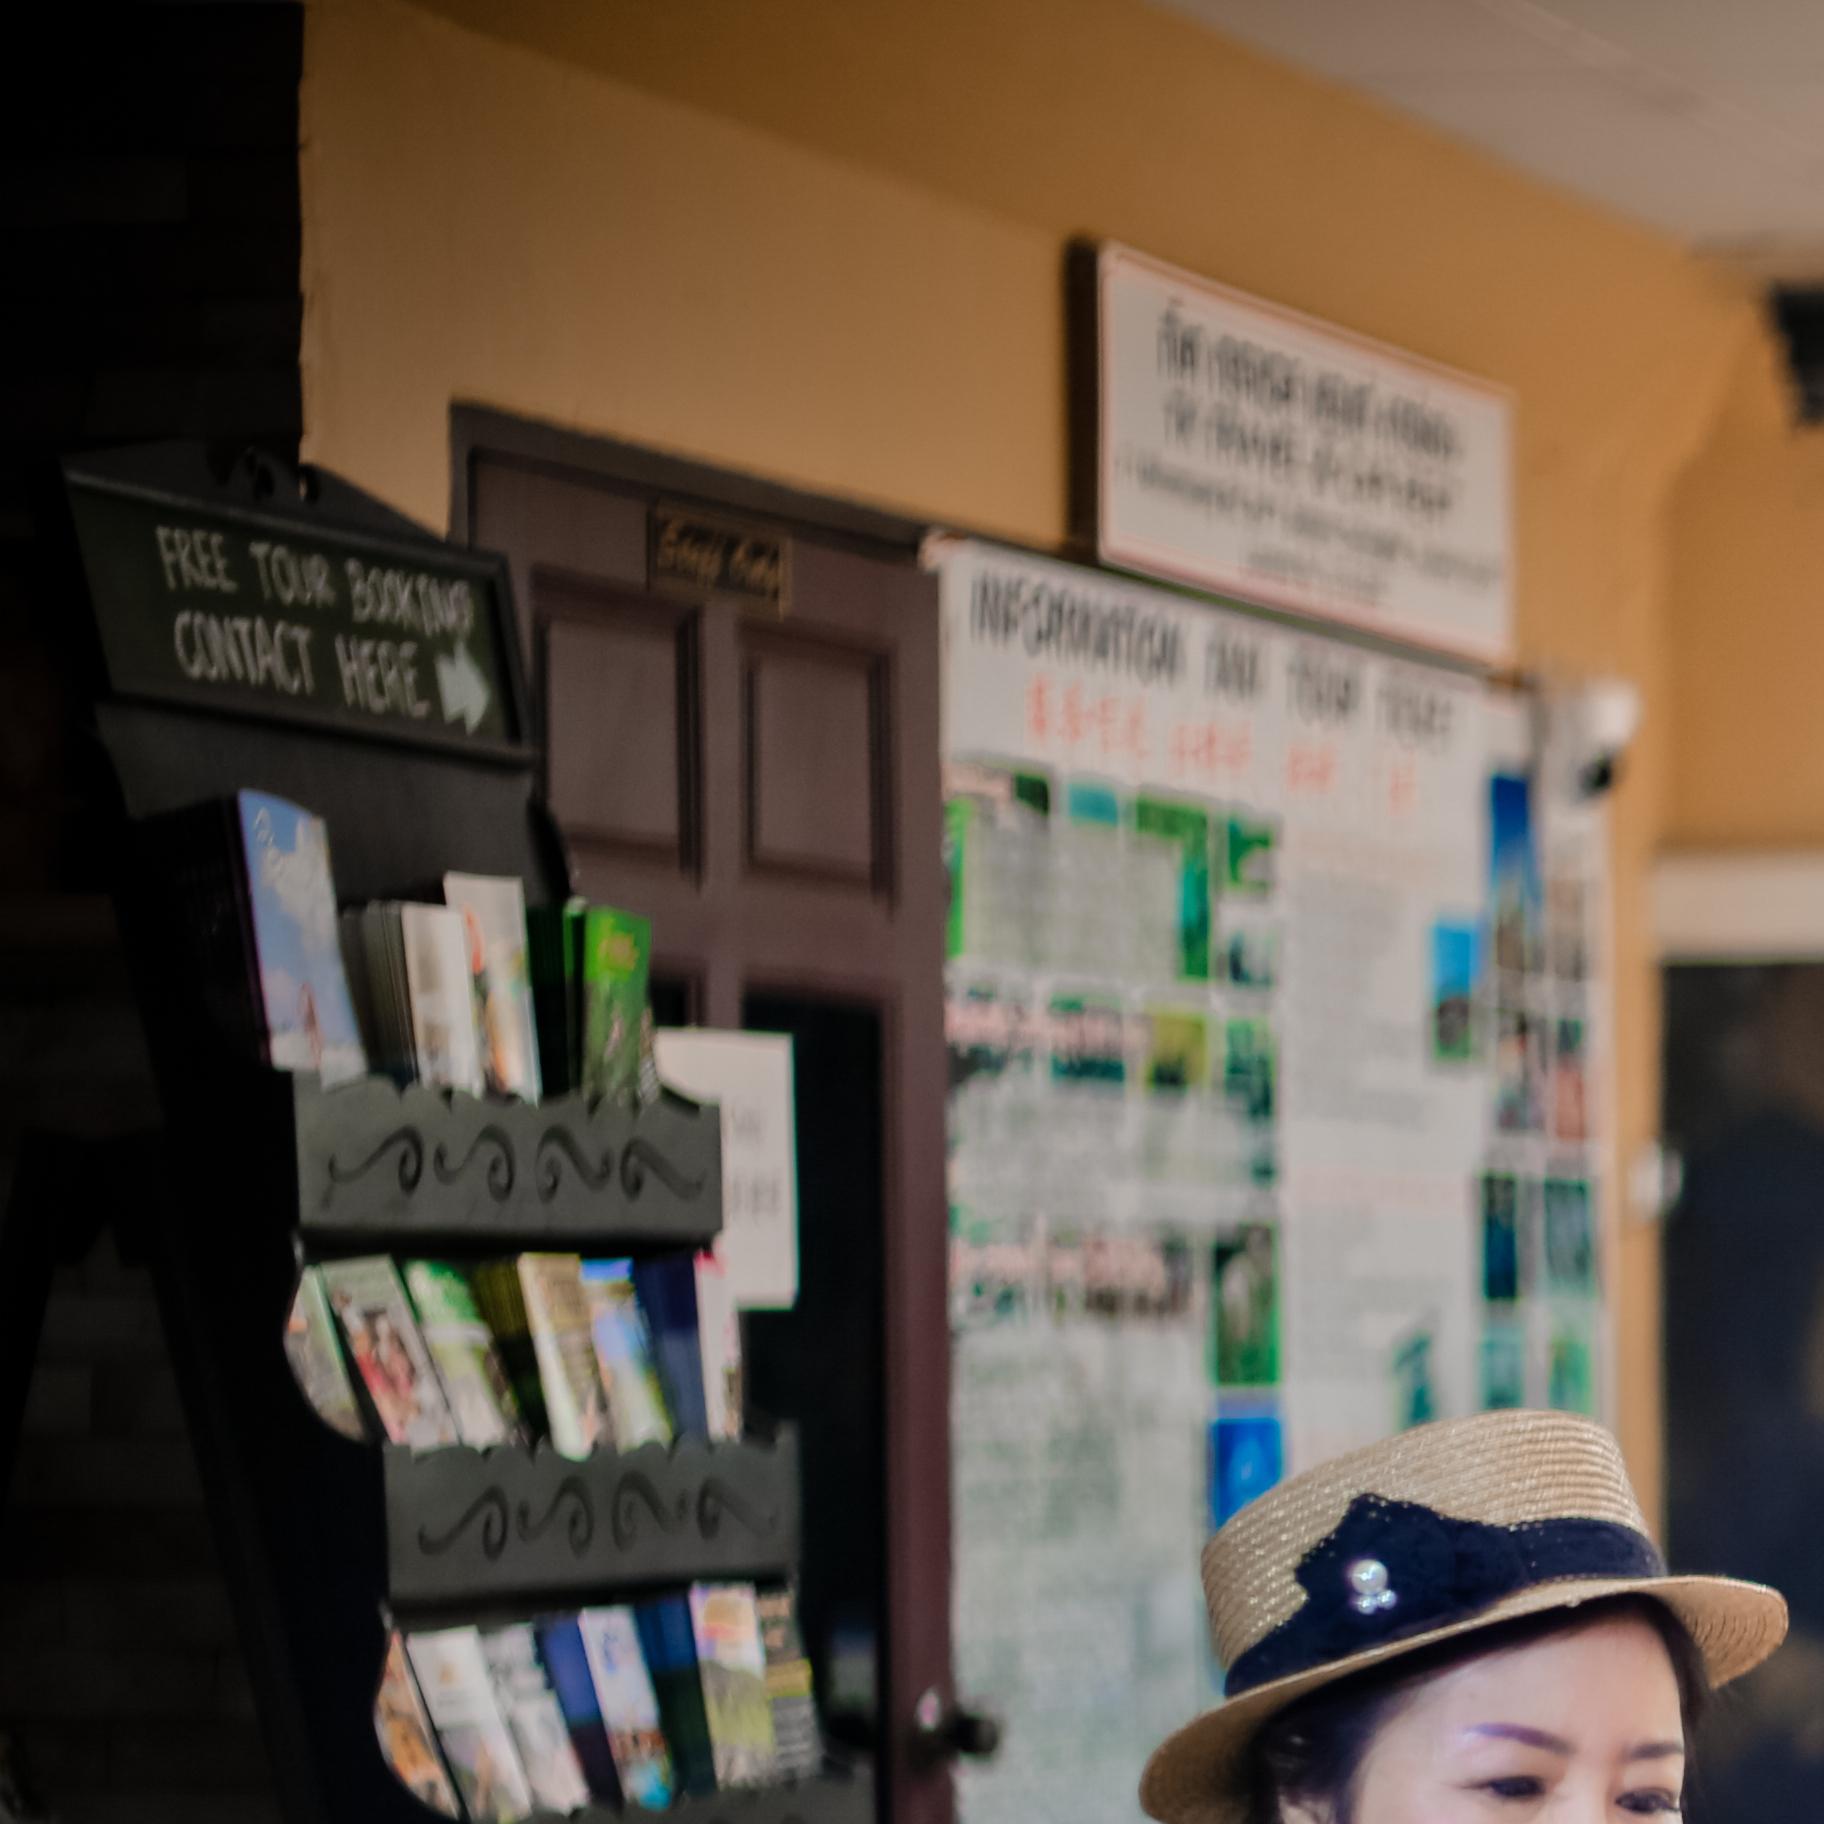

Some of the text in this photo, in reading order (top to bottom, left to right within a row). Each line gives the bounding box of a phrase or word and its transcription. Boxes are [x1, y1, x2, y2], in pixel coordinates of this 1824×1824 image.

[155, 525, 475, 638] FREE TOUR BOOKING
[173, 609, 430, 718] CONTACT HERE
